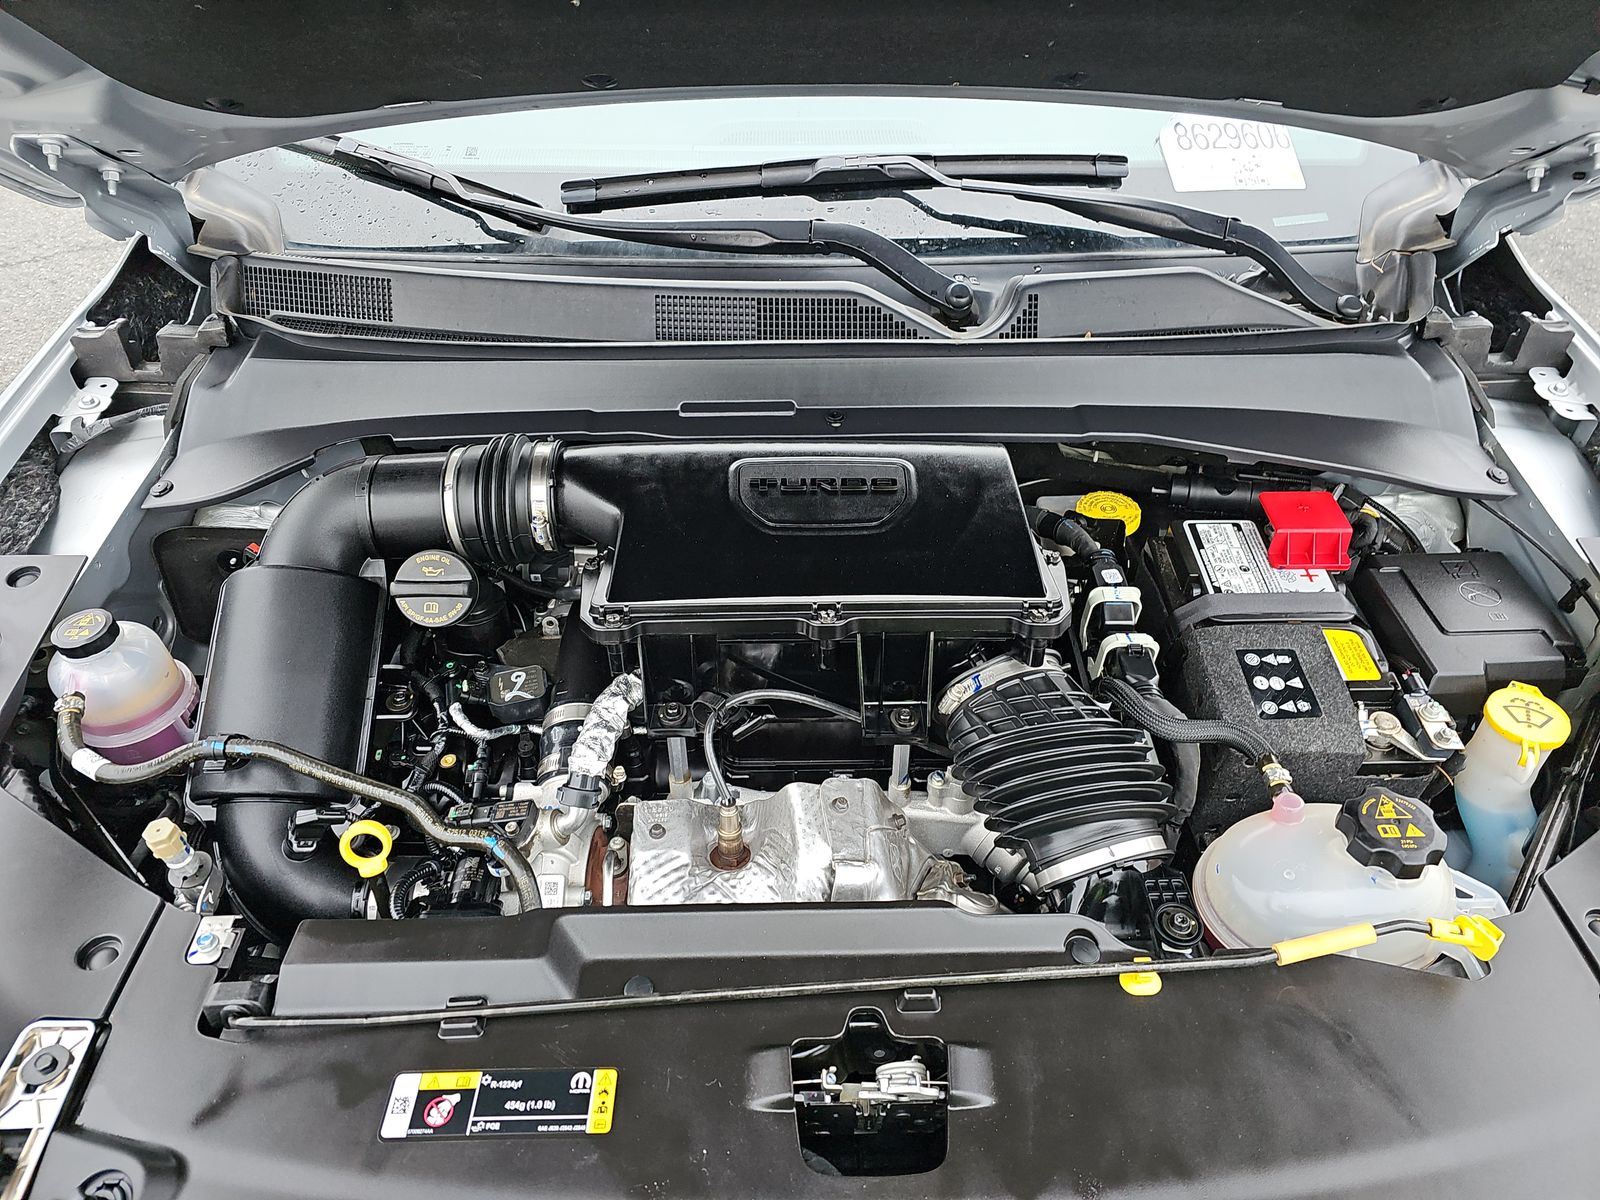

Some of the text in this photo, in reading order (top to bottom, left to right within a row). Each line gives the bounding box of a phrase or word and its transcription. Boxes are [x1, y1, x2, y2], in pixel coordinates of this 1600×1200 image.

[749, 476, 899, 493] TURBO
[415, 554, 451, 566] ENGINE OIL
[399, 600, 409, 611] API
[505, 671, 536, 702] 2
[490, 1080, 523, 1090] R-1234yf
[504, 1100, 526, 1112] 454g
